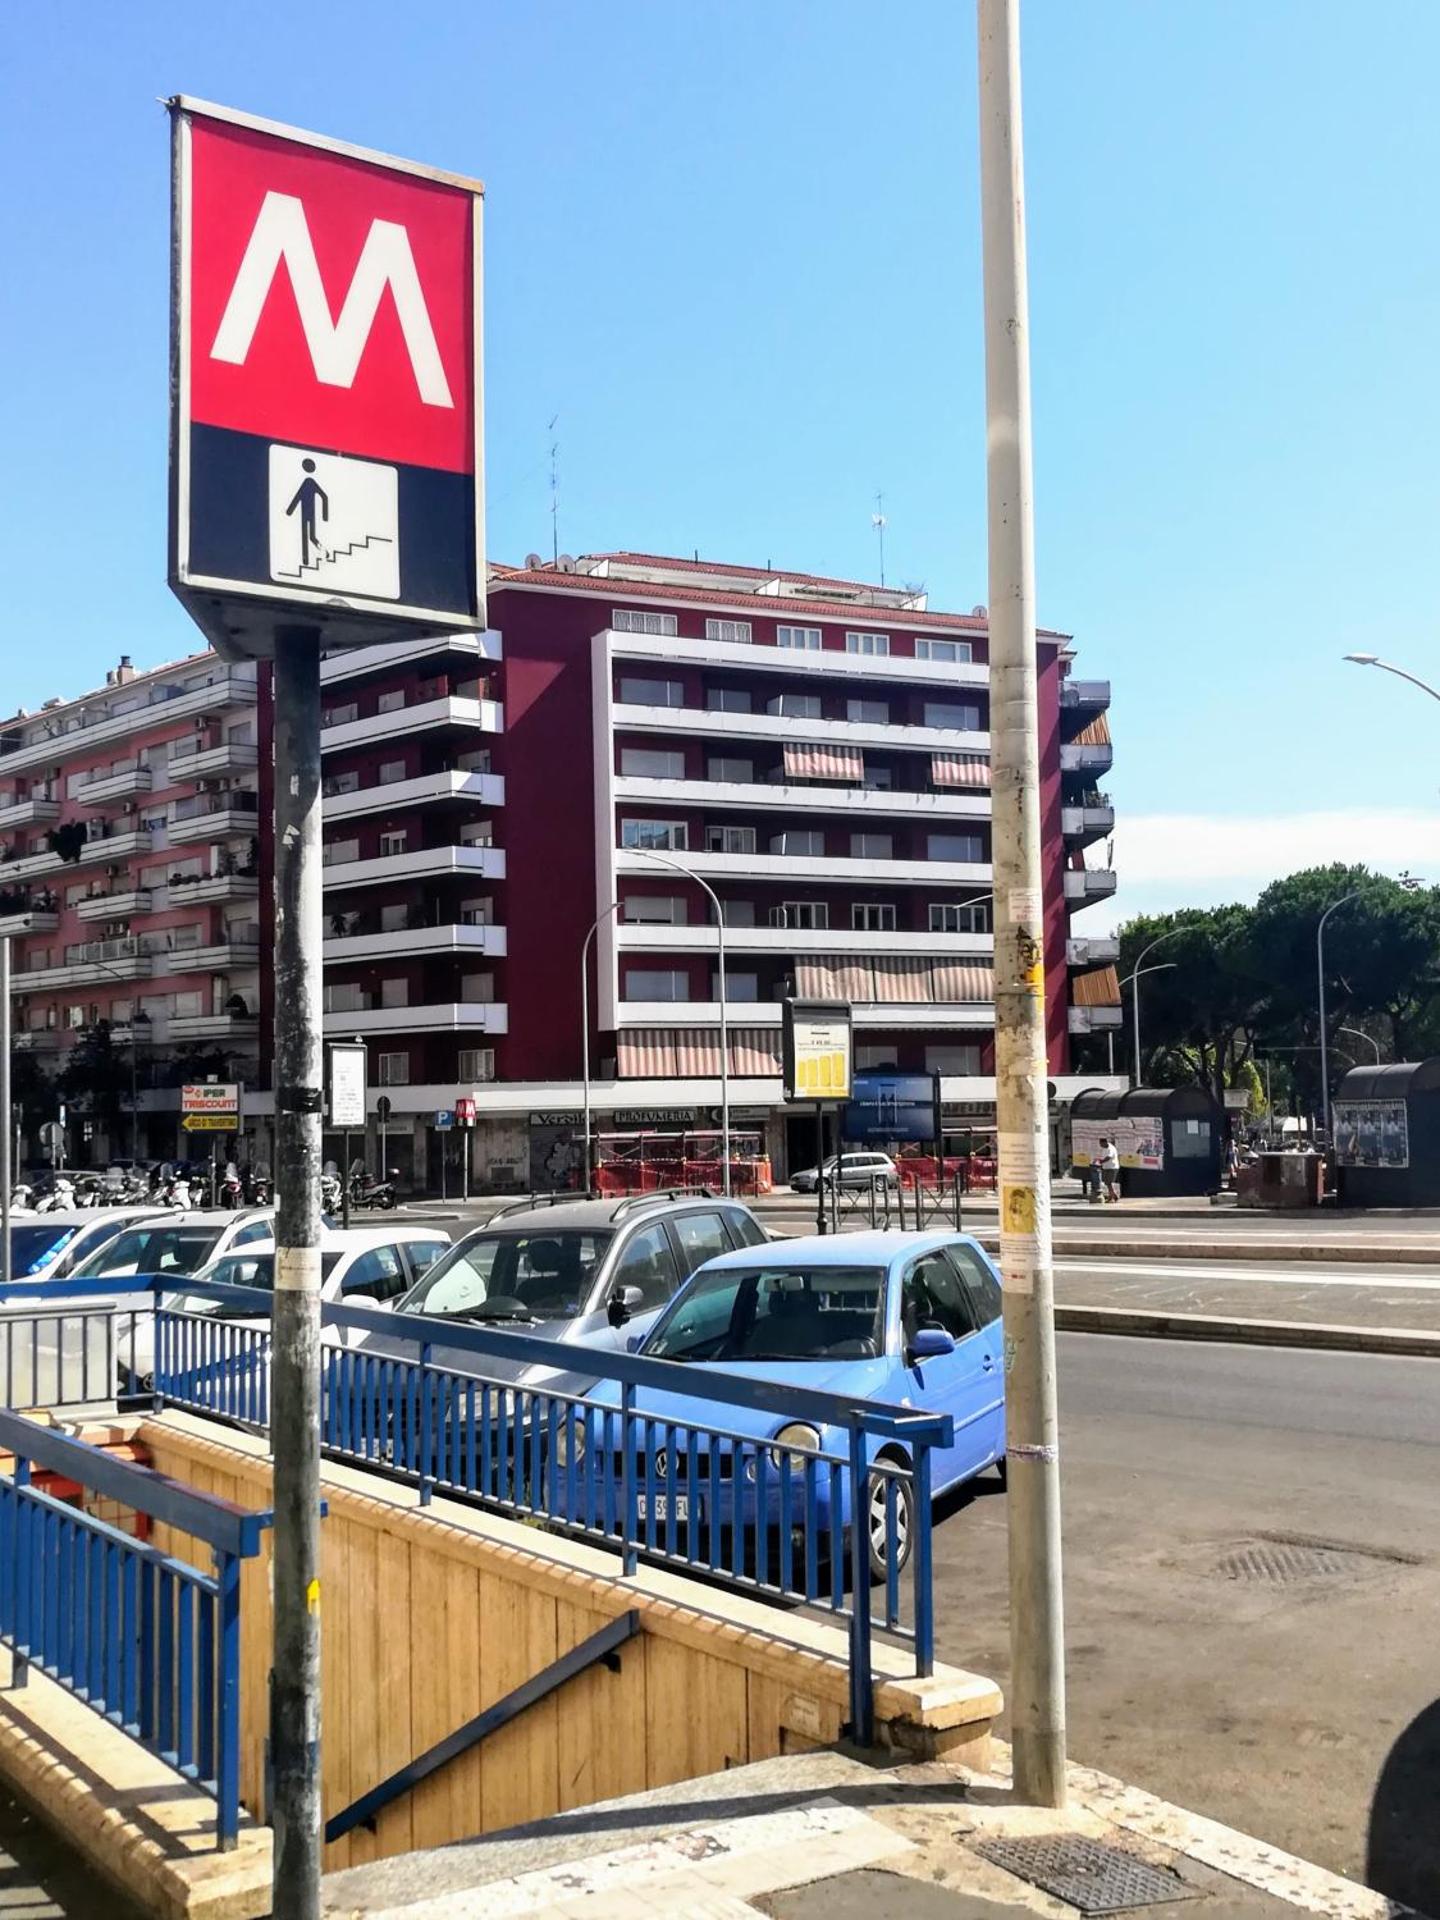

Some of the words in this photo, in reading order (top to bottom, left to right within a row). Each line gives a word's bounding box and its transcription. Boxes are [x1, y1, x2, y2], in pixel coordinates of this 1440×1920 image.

[210, 191, 455, 409] M
[438, 1111, 448, 1124] P
[618, 1110, 691, 1121] PROFUMERIA
